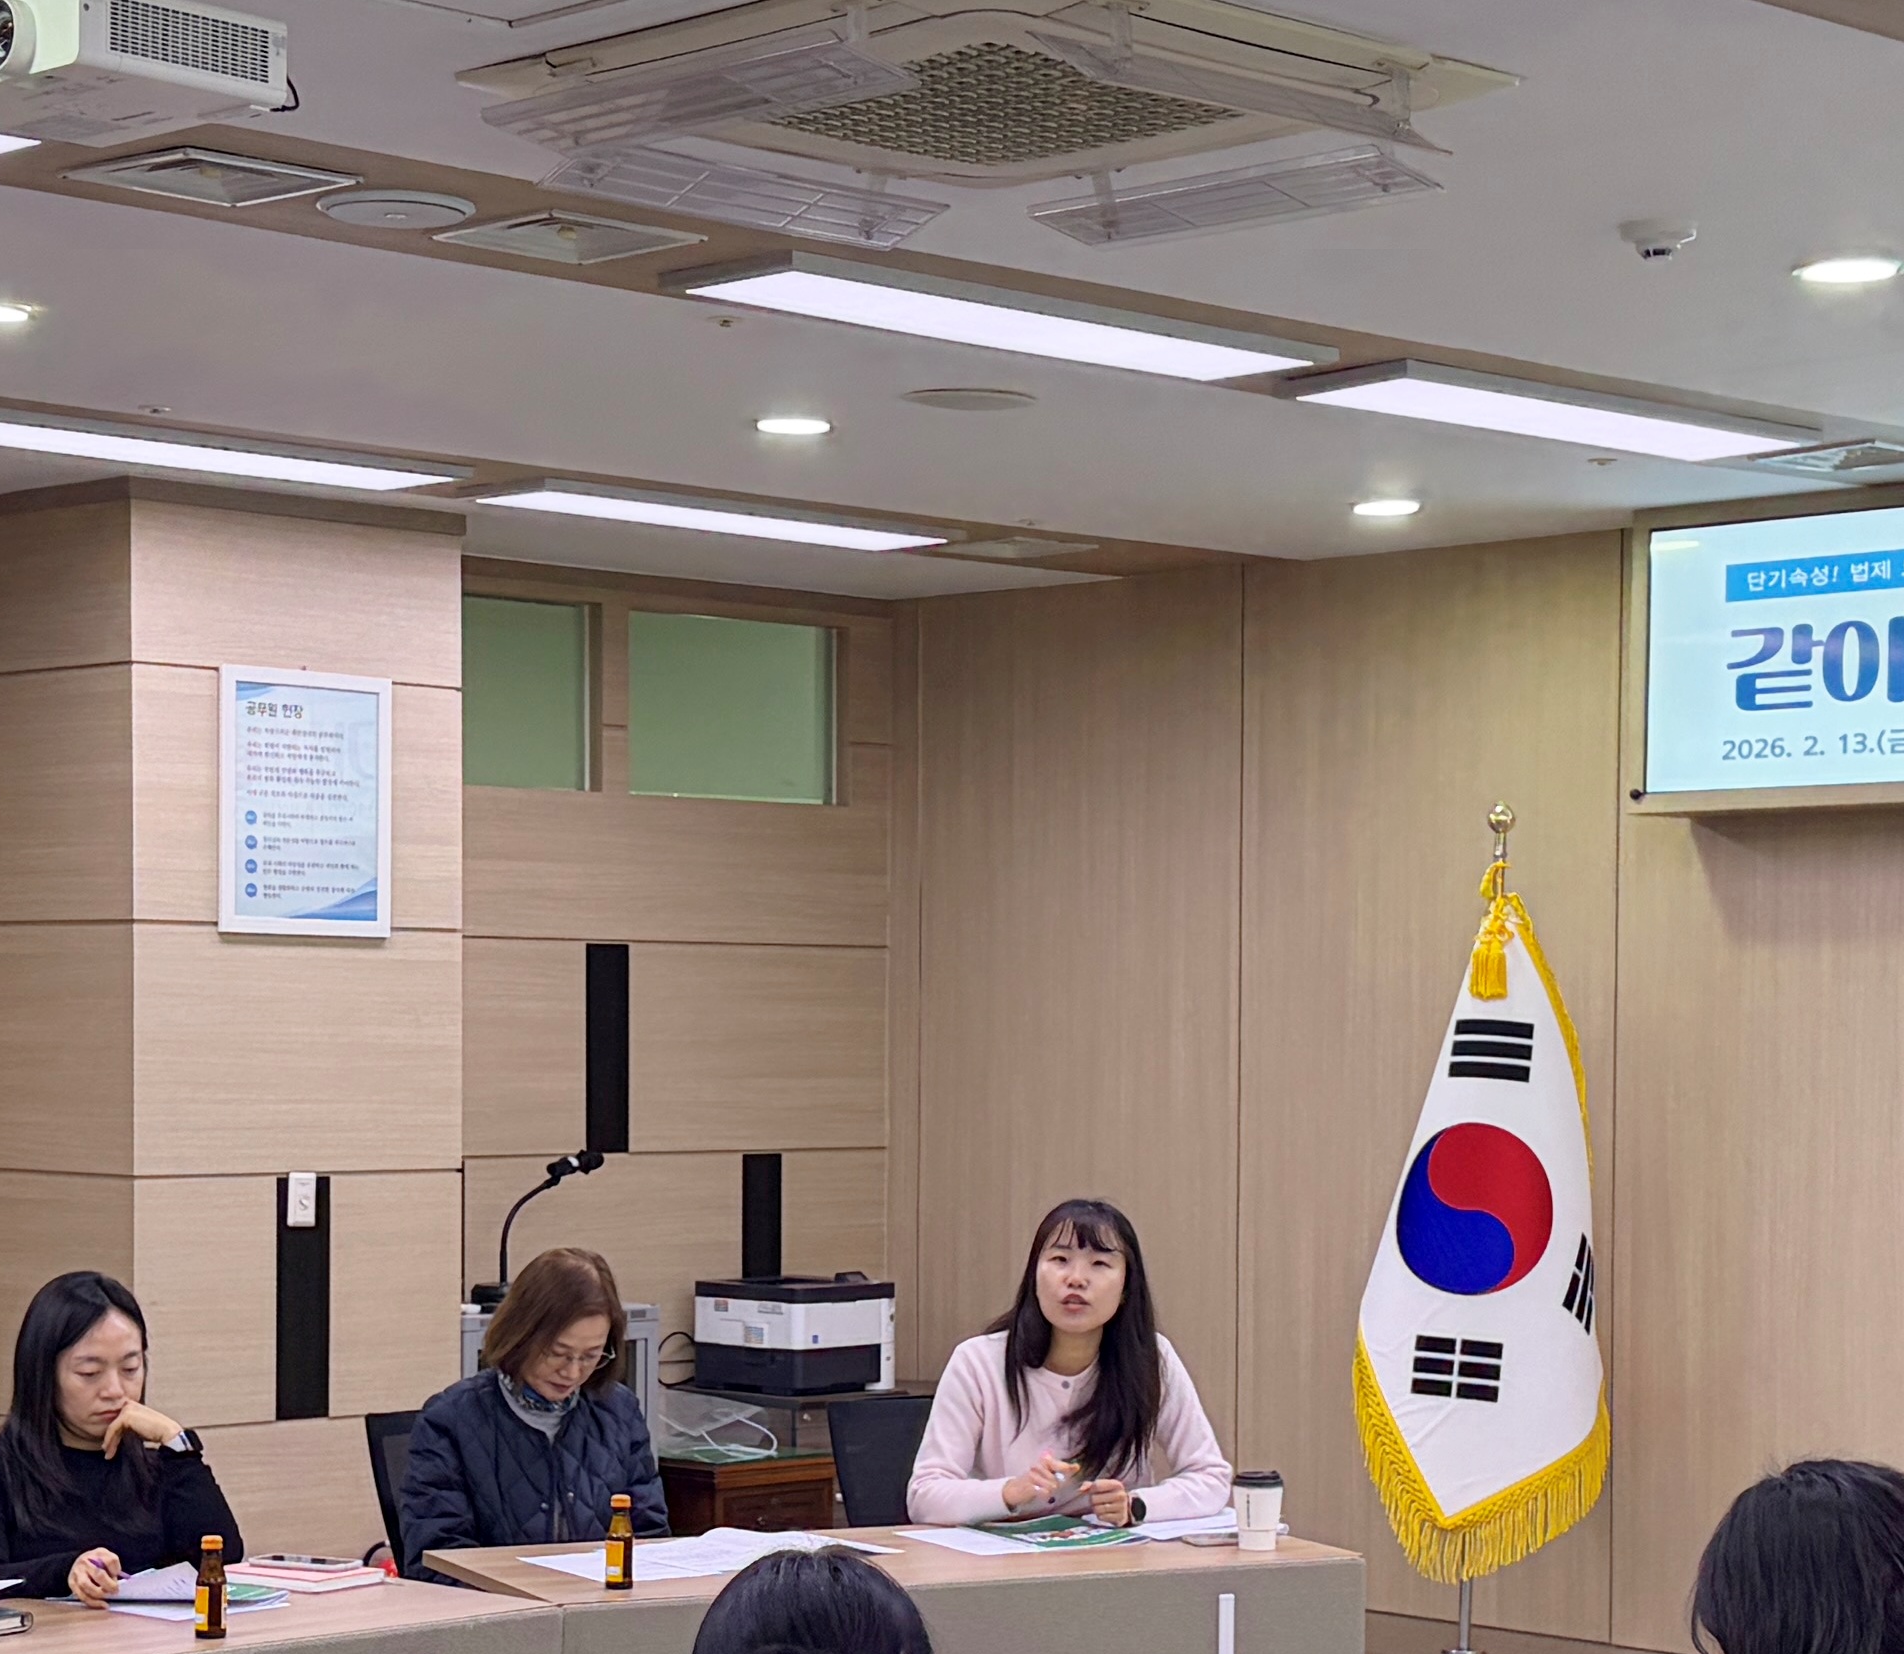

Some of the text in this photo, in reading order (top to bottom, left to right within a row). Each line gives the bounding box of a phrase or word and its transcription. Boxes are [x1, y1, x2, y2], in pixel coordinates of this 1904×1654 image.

[1746, 563, 1840, 592] 단기속성!
[1850, 556, 1892, 582] 법제
[1721, 739, 1792, 762] 2026.
[1803, 734, 1825, 757] 2.
